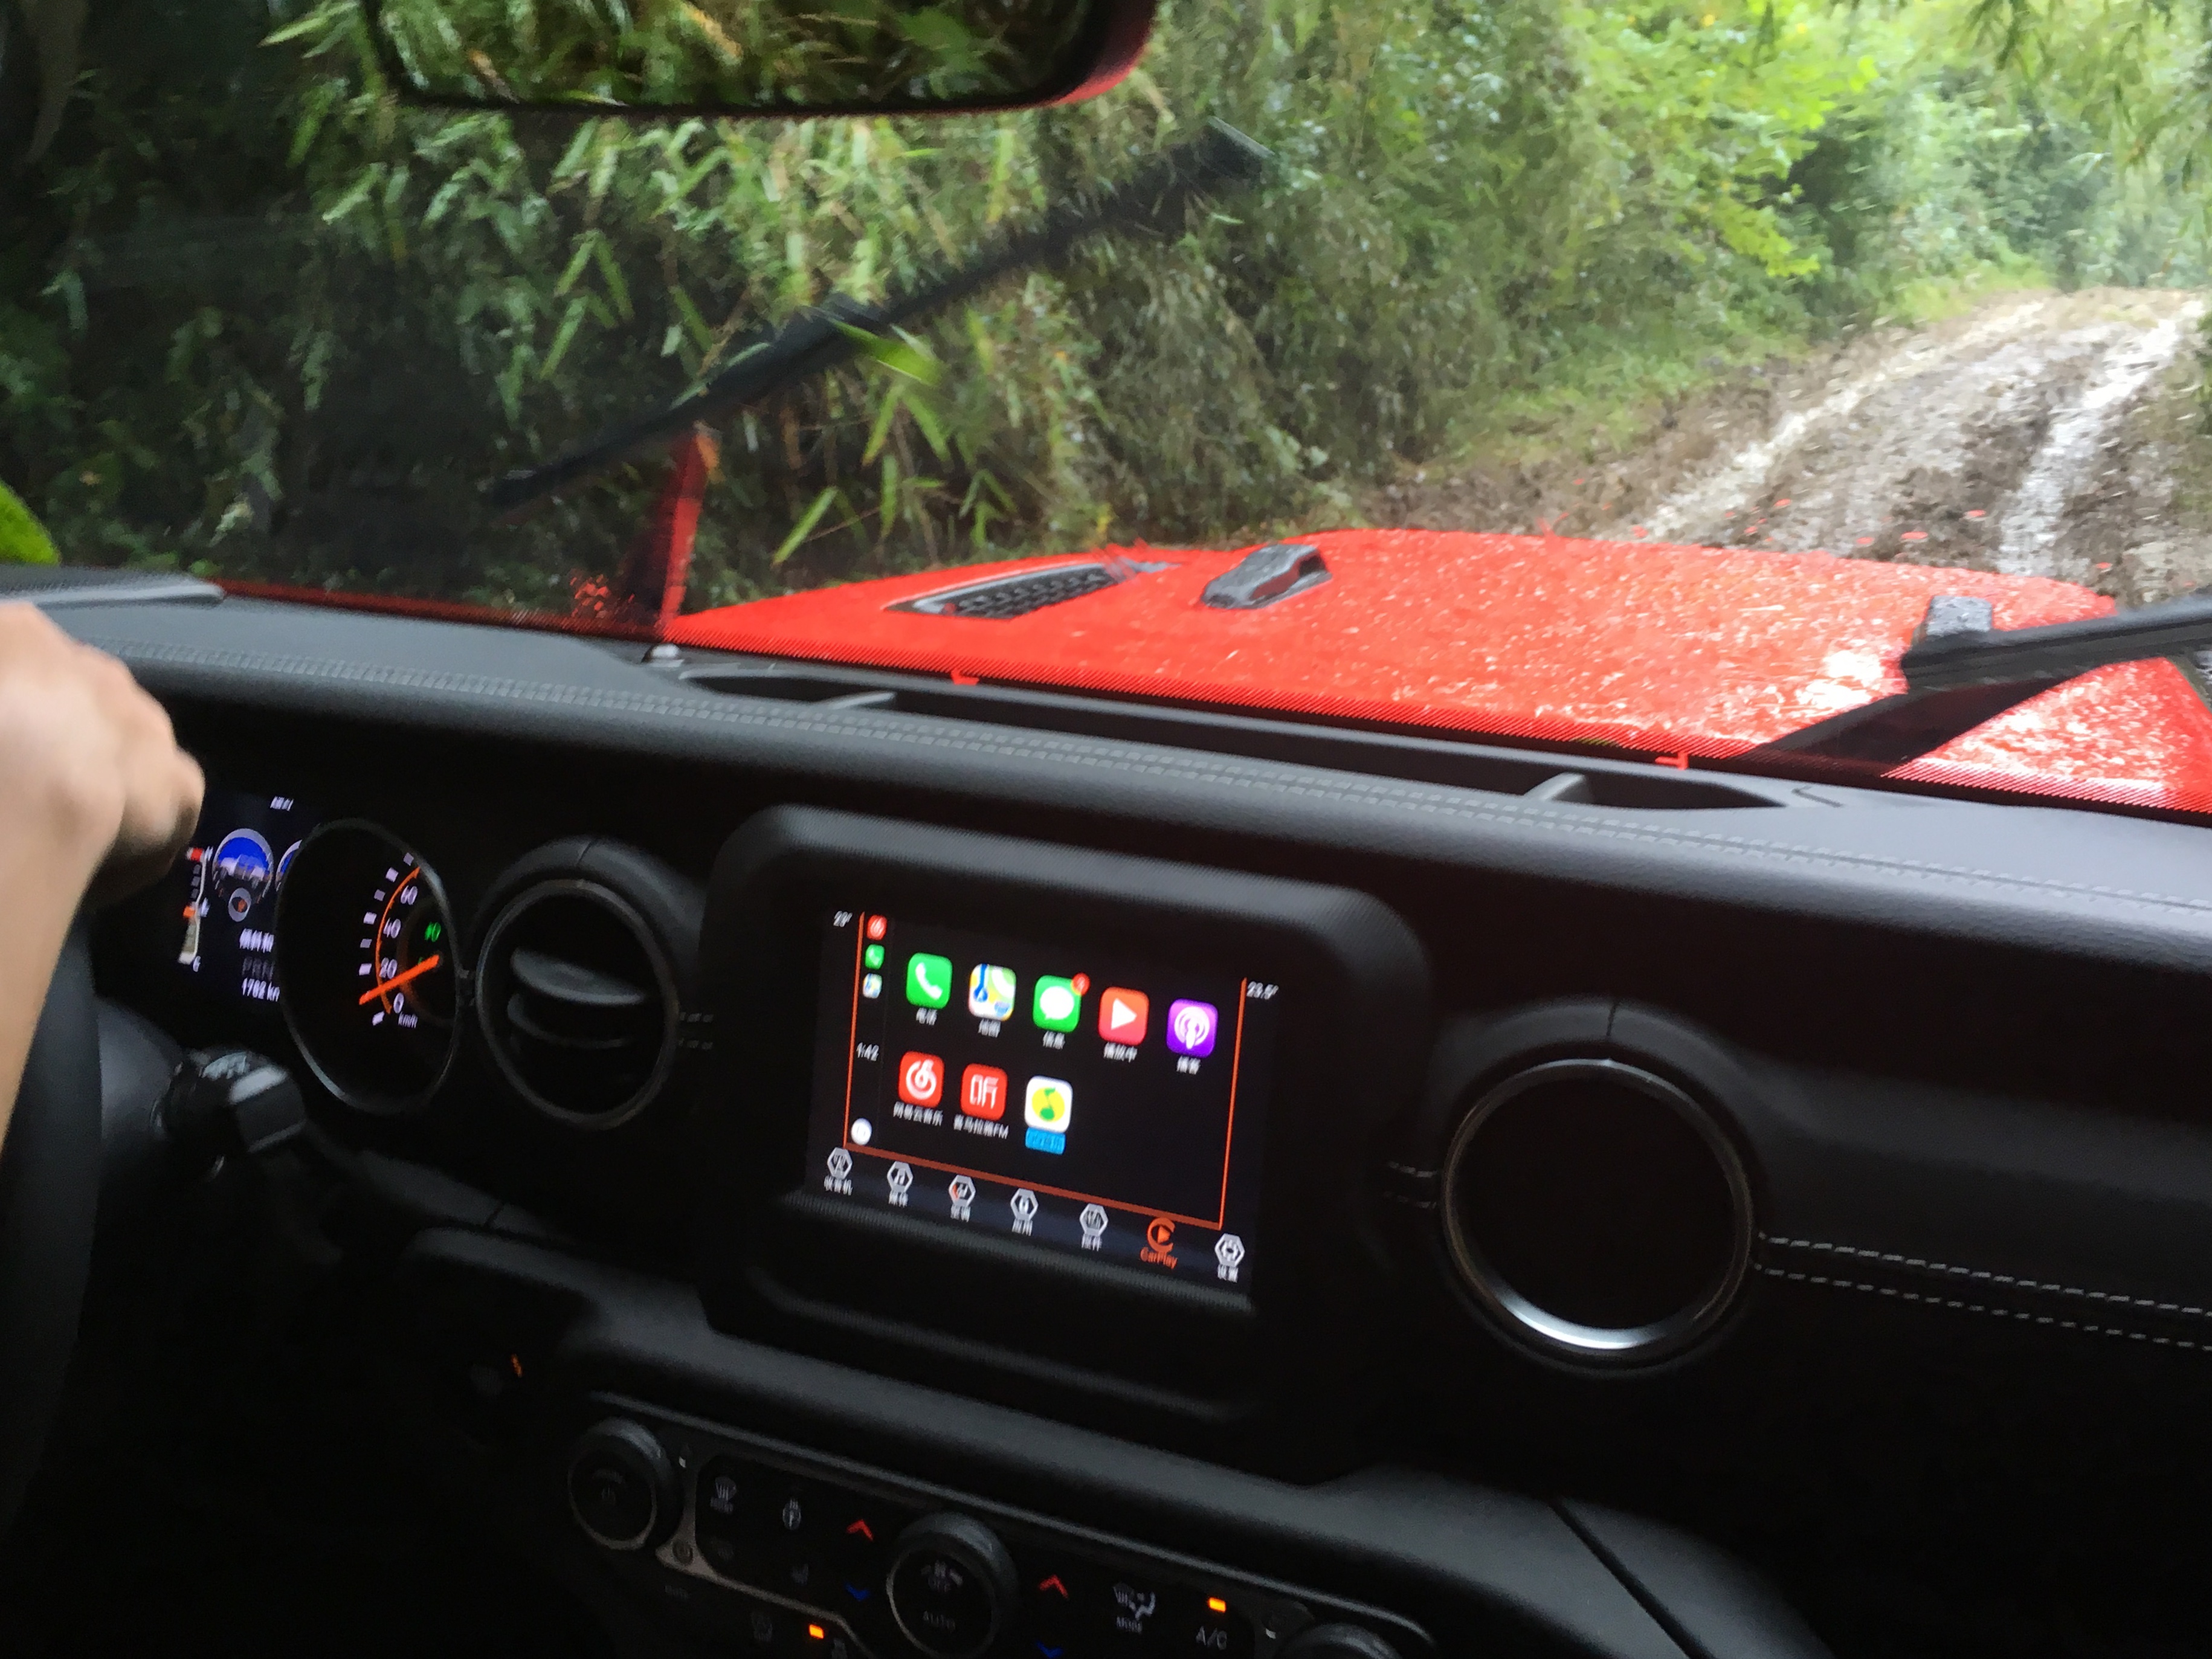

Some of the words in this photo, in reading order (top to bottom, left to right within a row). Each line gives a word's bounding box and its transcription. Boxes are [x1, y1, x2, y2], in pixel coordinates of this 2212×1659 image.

[400, 885, 418, 905] 60
[383, 918, 401, 939] 40
[379, 958, 398, 979] 20
[393, 992, 404, 1014] 0
[398, 1012, 418, 1028] km/h
[856, 1042, 879, 1061] 1:42
[893, 1101, 944, 1126] 网易云音乐
[953, 1114, 1010, 1140] 喜马拉雅FM
[1140, 1246, 1178, 1269] CarPlay
[1196, 1626, 1228, 1651] A/C
